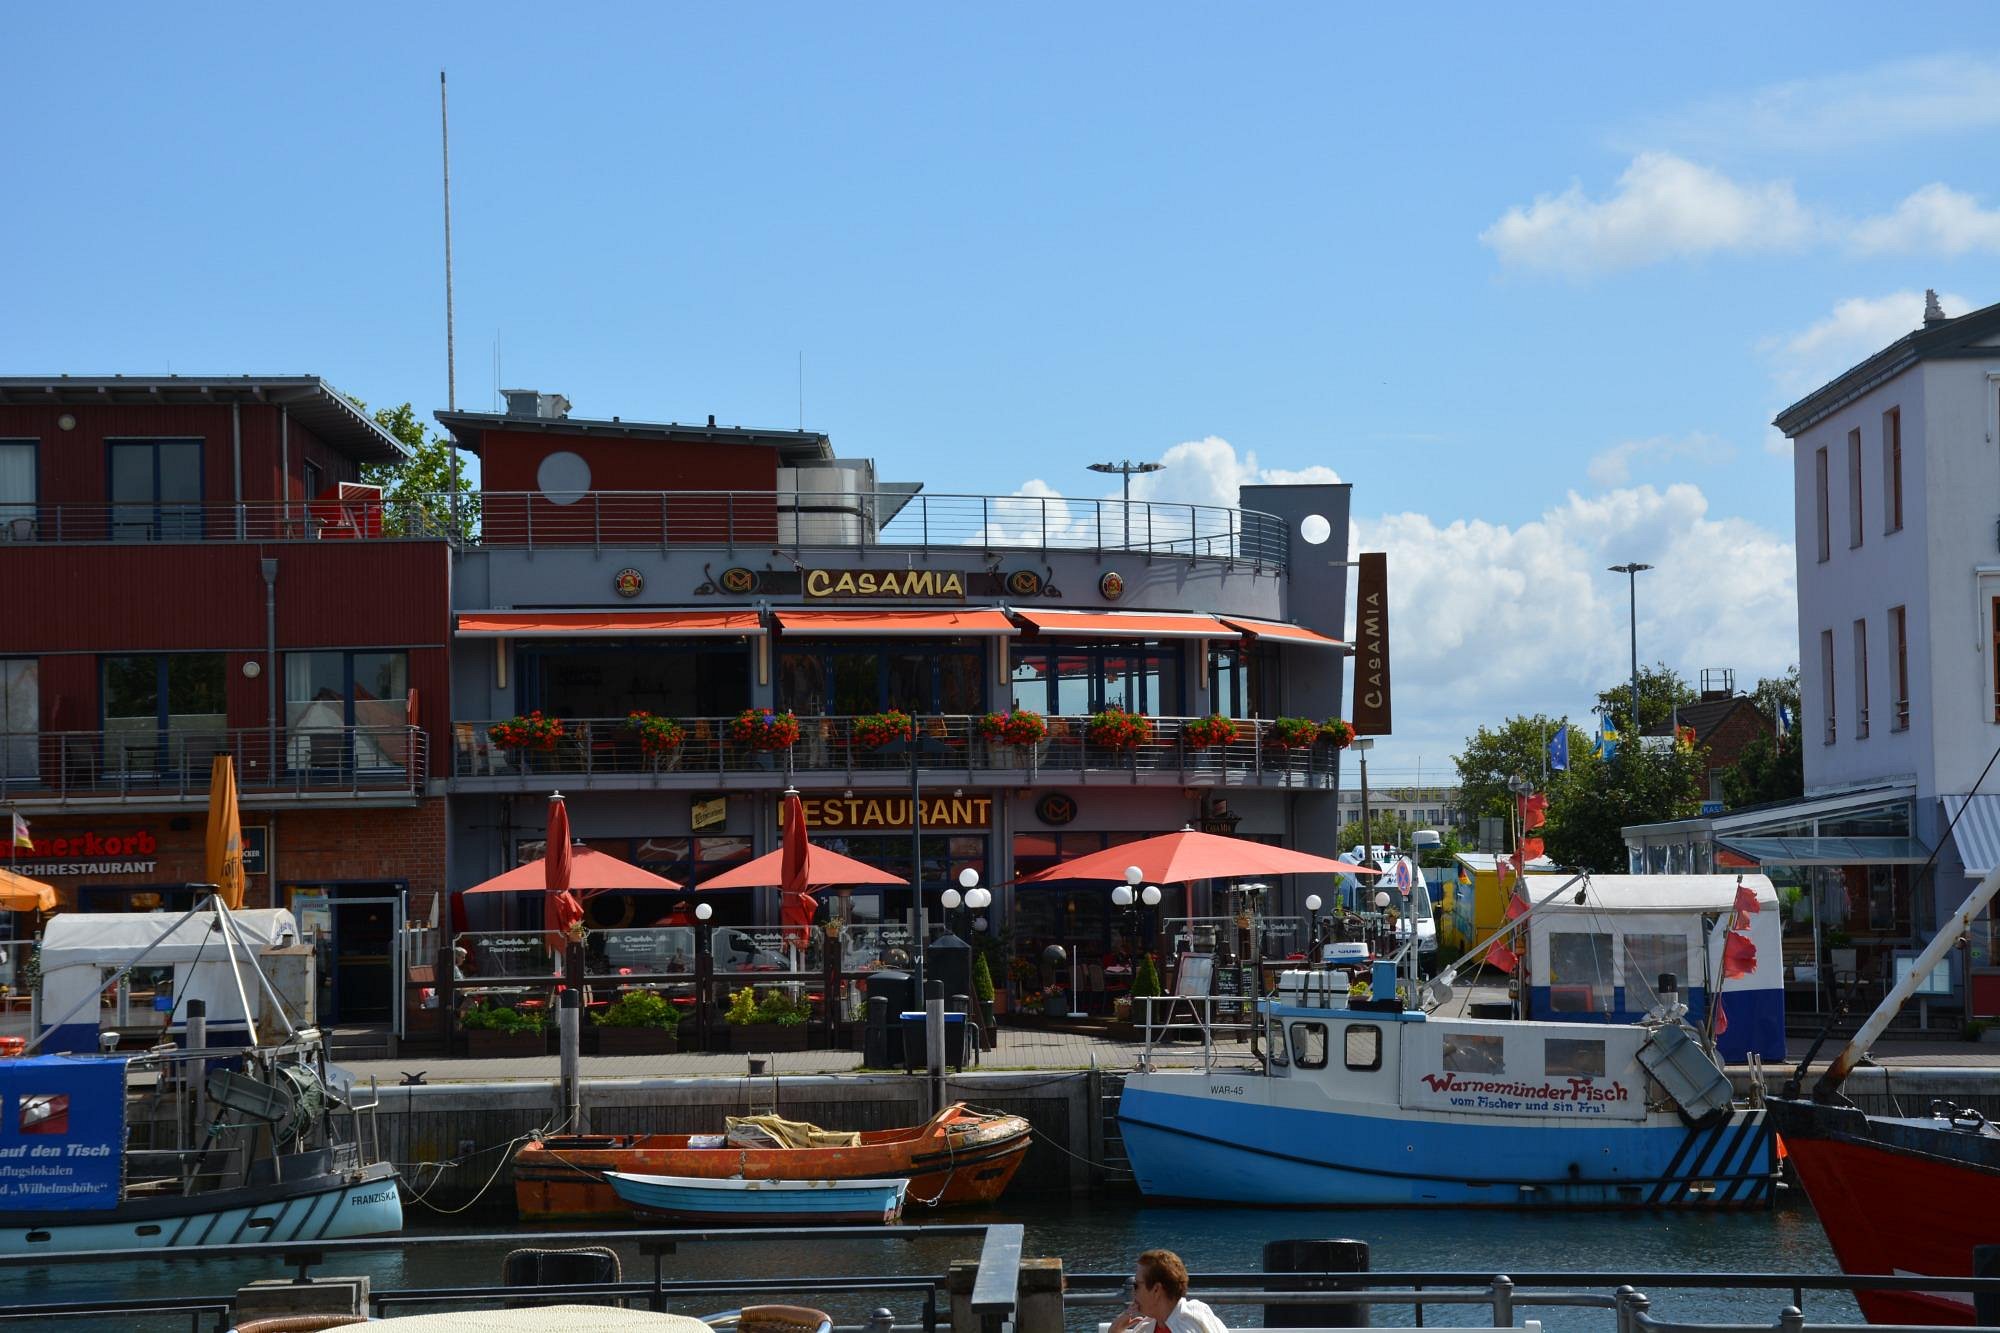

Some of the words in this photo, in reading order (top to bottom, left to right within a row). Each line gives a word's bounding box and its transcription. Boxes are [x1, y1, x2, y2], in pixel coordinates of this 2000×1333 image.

[1364, 592, 1383, 709] CASAMIA
[1210, 1085, 1244, 1095] WAR-45
[1450, 1096, 1475, 1107] vom
[1478, 1096, 1521, 1110] Fischer
[1525, 1100, 1549, 1111] und
[1553, 1101, 1573, 1112] sin
[0, 1145, 28, 1158] auf
[30, 1144, 62, 1157] den
[66, 1143, 111, 1157] Tisch
[351, 1191, 397, 1206] FRANZISKA
